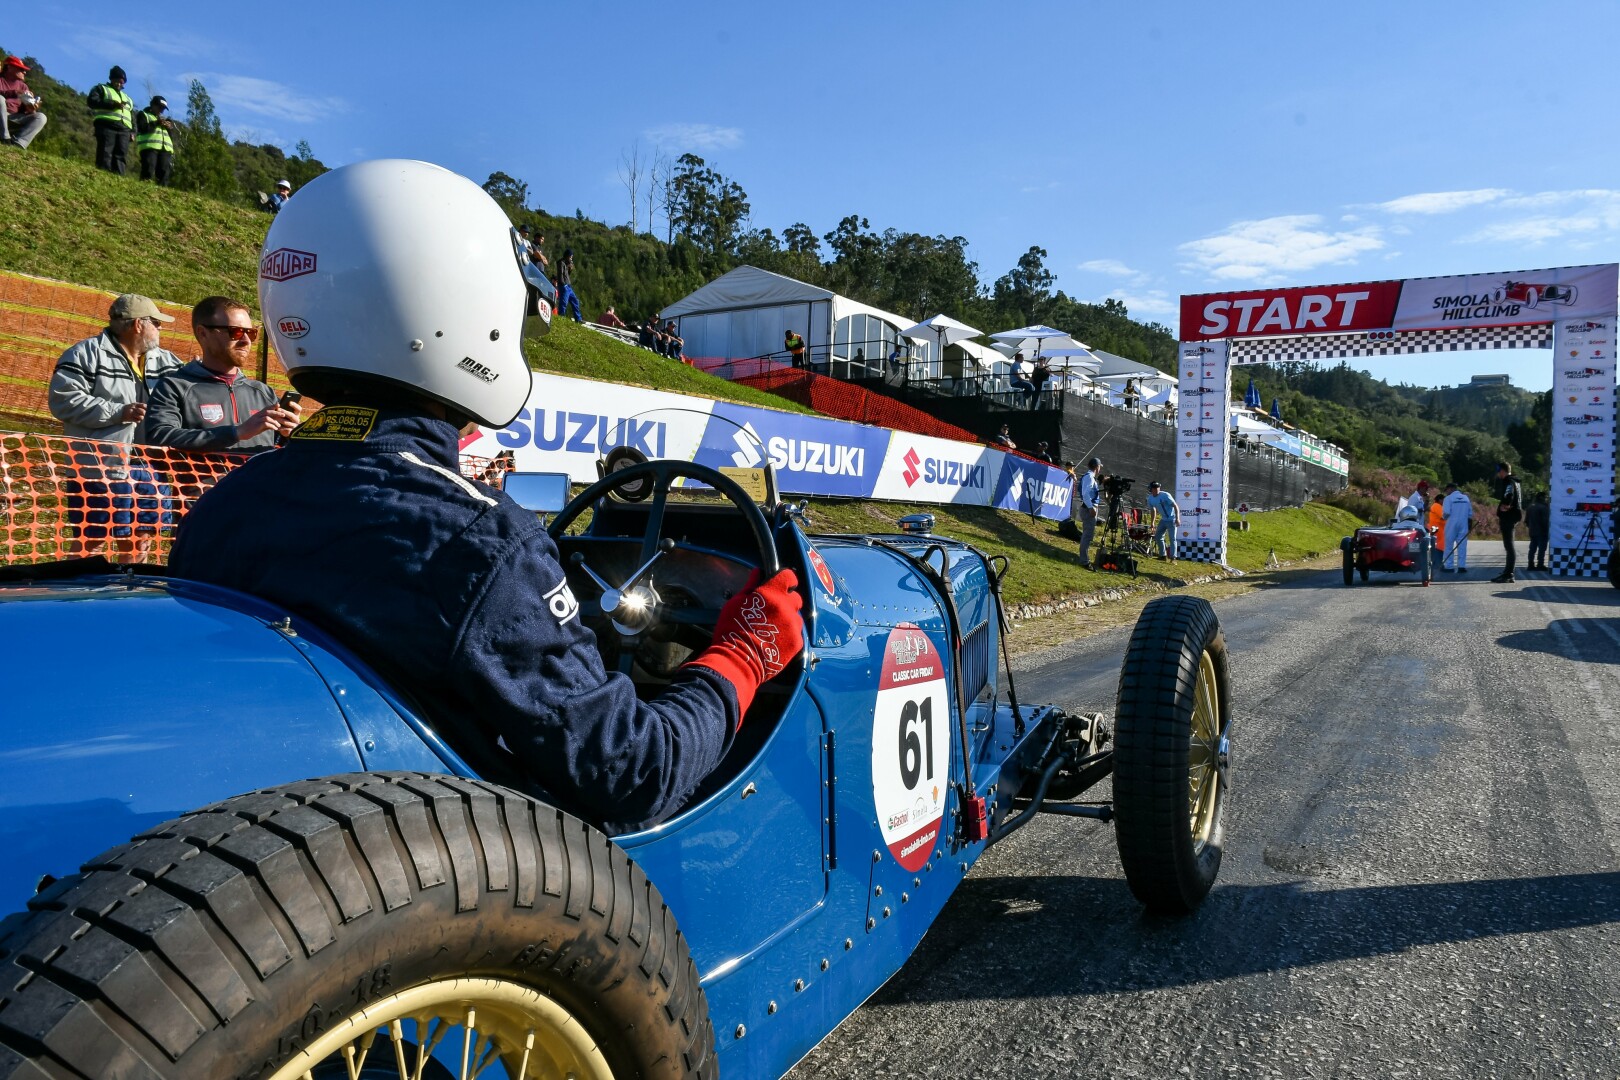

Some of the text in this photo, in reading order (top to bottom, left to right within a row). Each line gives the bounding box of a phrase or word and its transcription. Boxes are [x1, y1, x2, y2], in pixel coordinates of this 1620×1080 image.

[260, 252, 312, 276] JAGUAR
[1199, 291, 1370, 335] START
[1432, 294, 1490, 309] SIMOLA
[1442, 304, 1520, 321] HILLCLIMB
[280, 321, 306, 332] BELL
[325, 416, 370, 426] RS.088.05
[496, 408, 666, 458] SUZUKI
[768, 436, 865, 477] SUZUKI
[924, 457, 985, 489] SUZUKI
[1026, 477, 1073, 508] SUZUKI
[550, 584, 577, 618] OM
[892, 666, 934, 682] CLASSIC CAR FRIDAY
[899, 696, 934, 790] 61
[894, 811, 909, 828] Castrol
